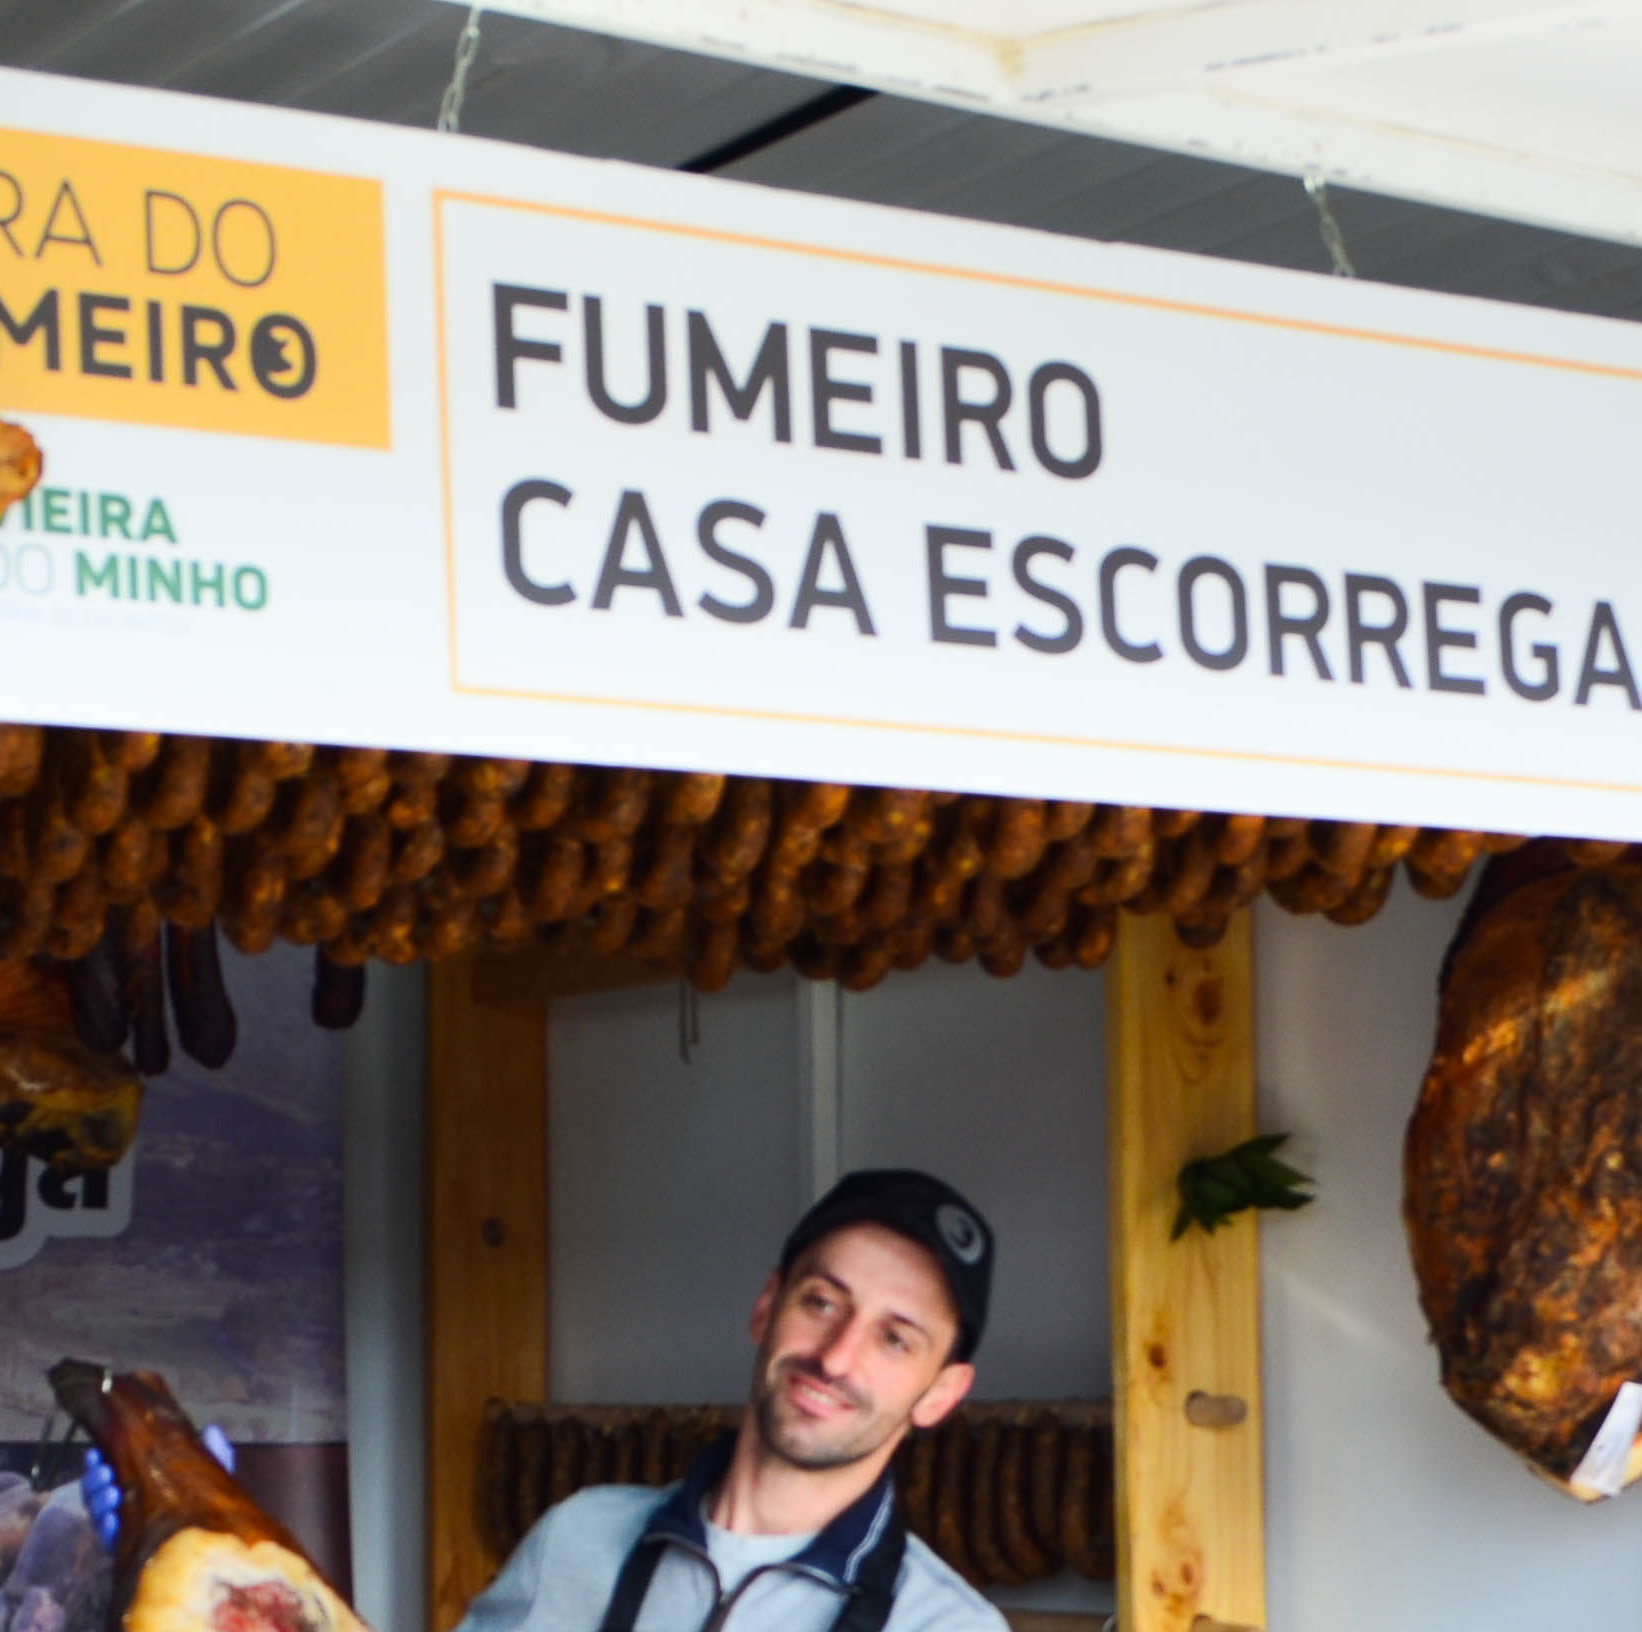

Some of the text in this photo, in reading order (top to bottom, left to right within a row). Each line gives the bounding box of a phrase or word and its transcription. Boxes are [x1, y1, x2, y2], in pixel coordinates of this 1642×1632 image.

[142, 188, 279, 288] DO
[491, 280, 1105, 482] FUMEIRO
[74, 549, 268, 612] MINHO
[500, 478, 879, 640] CASA
